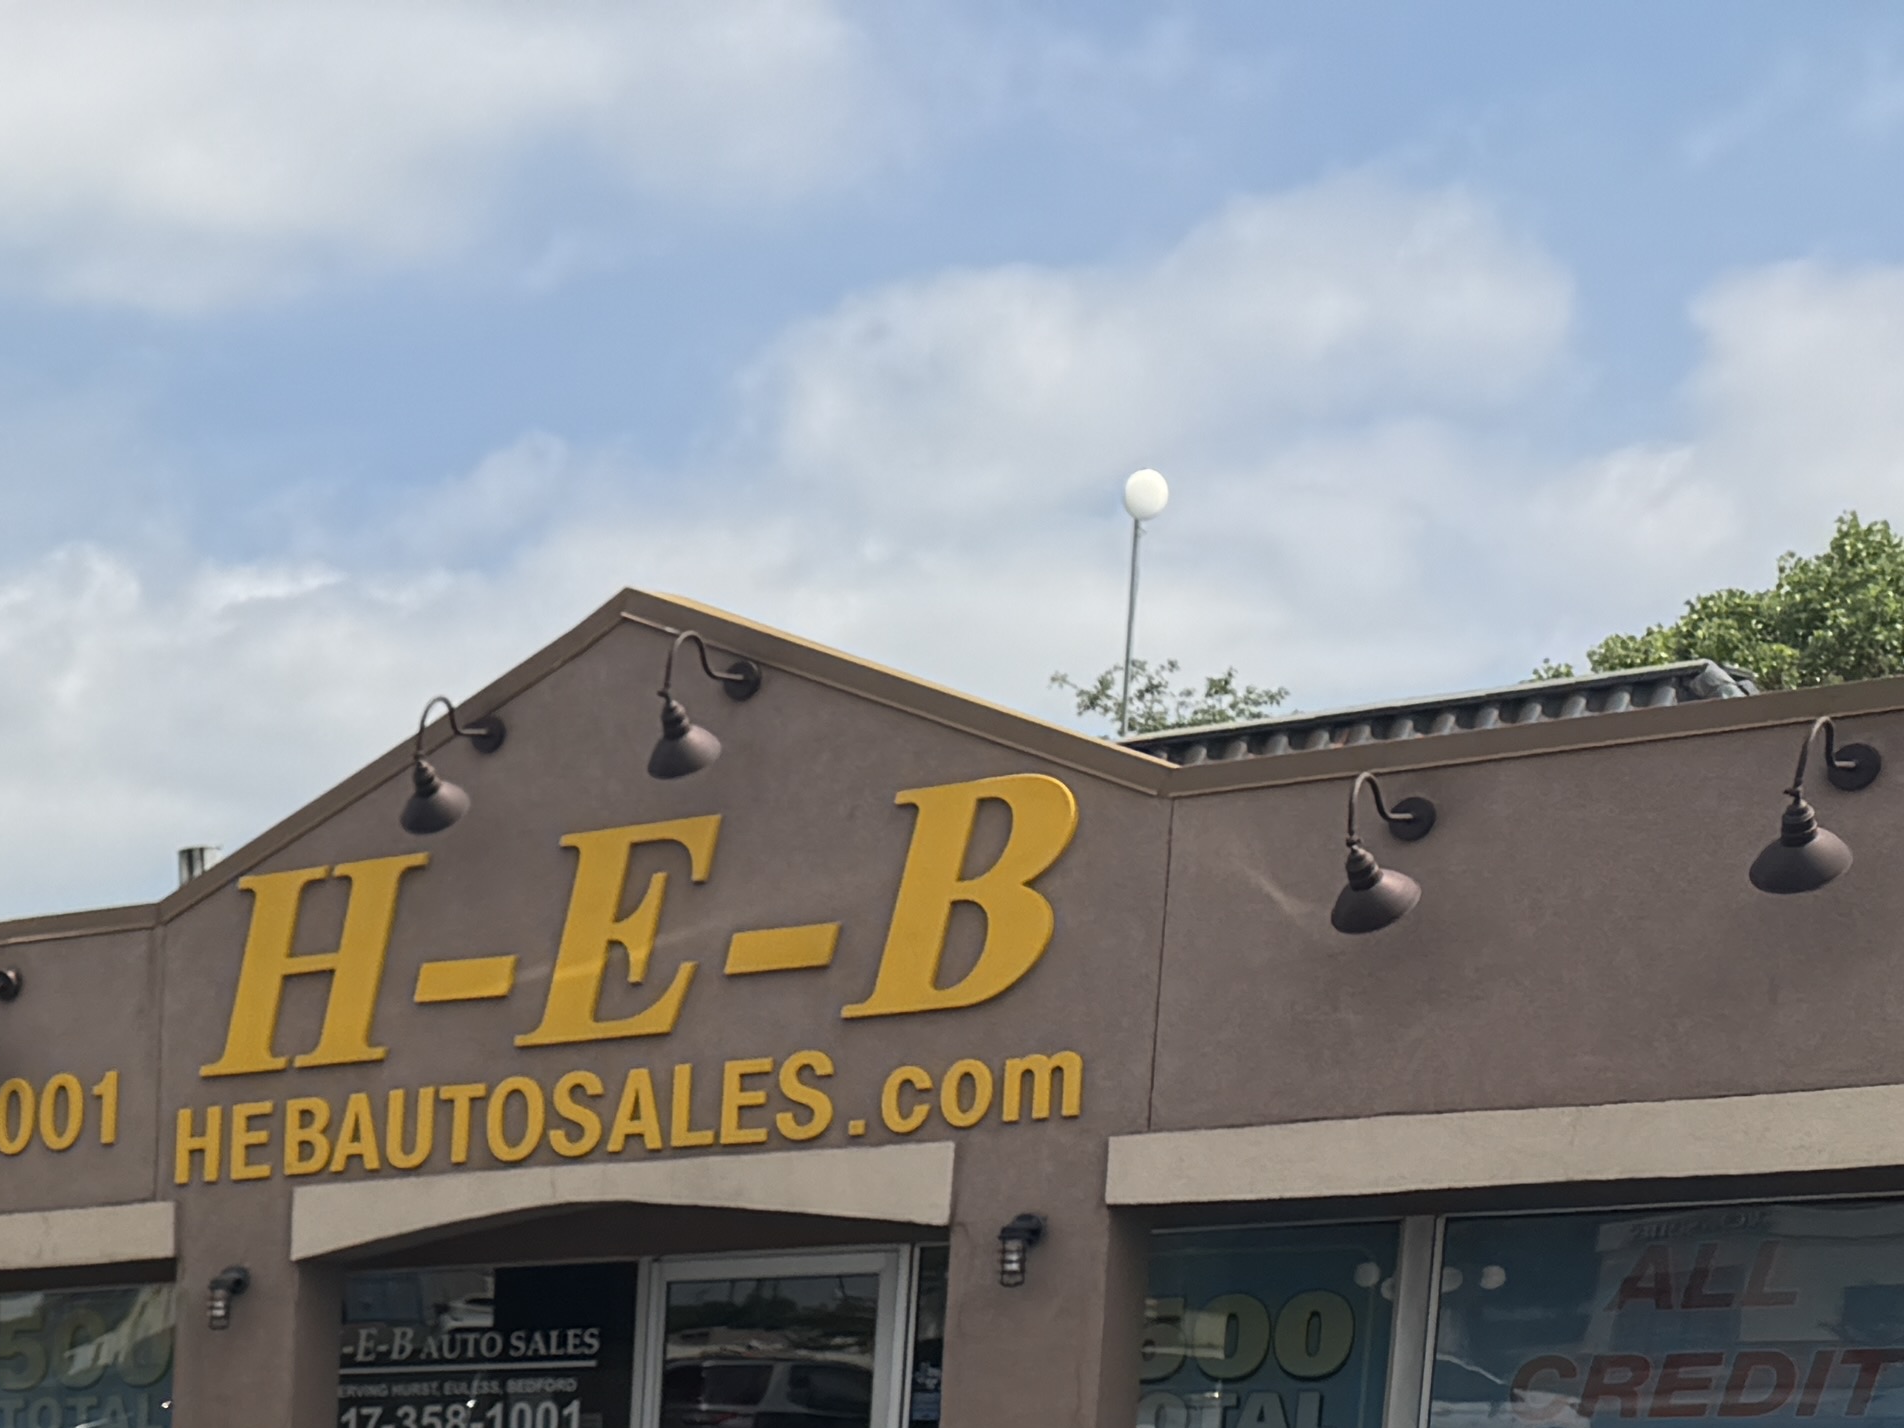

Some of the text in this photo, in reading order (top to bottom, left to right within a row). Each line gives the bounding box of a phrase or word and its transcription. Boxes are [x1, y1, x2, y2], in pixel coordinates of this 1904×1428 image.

[201, 774, 1080, 1079] H-E-B
[175, 1052, 1085, 1185] HEBAUTOSALES.com
[1604, 1240, 1799, 1312] ALL
[419, 1333, 504, 1360] AUTO
[509, 1328, 600, 1358] SALES
[1510, 1347, 1904, 1421] CREDIT
